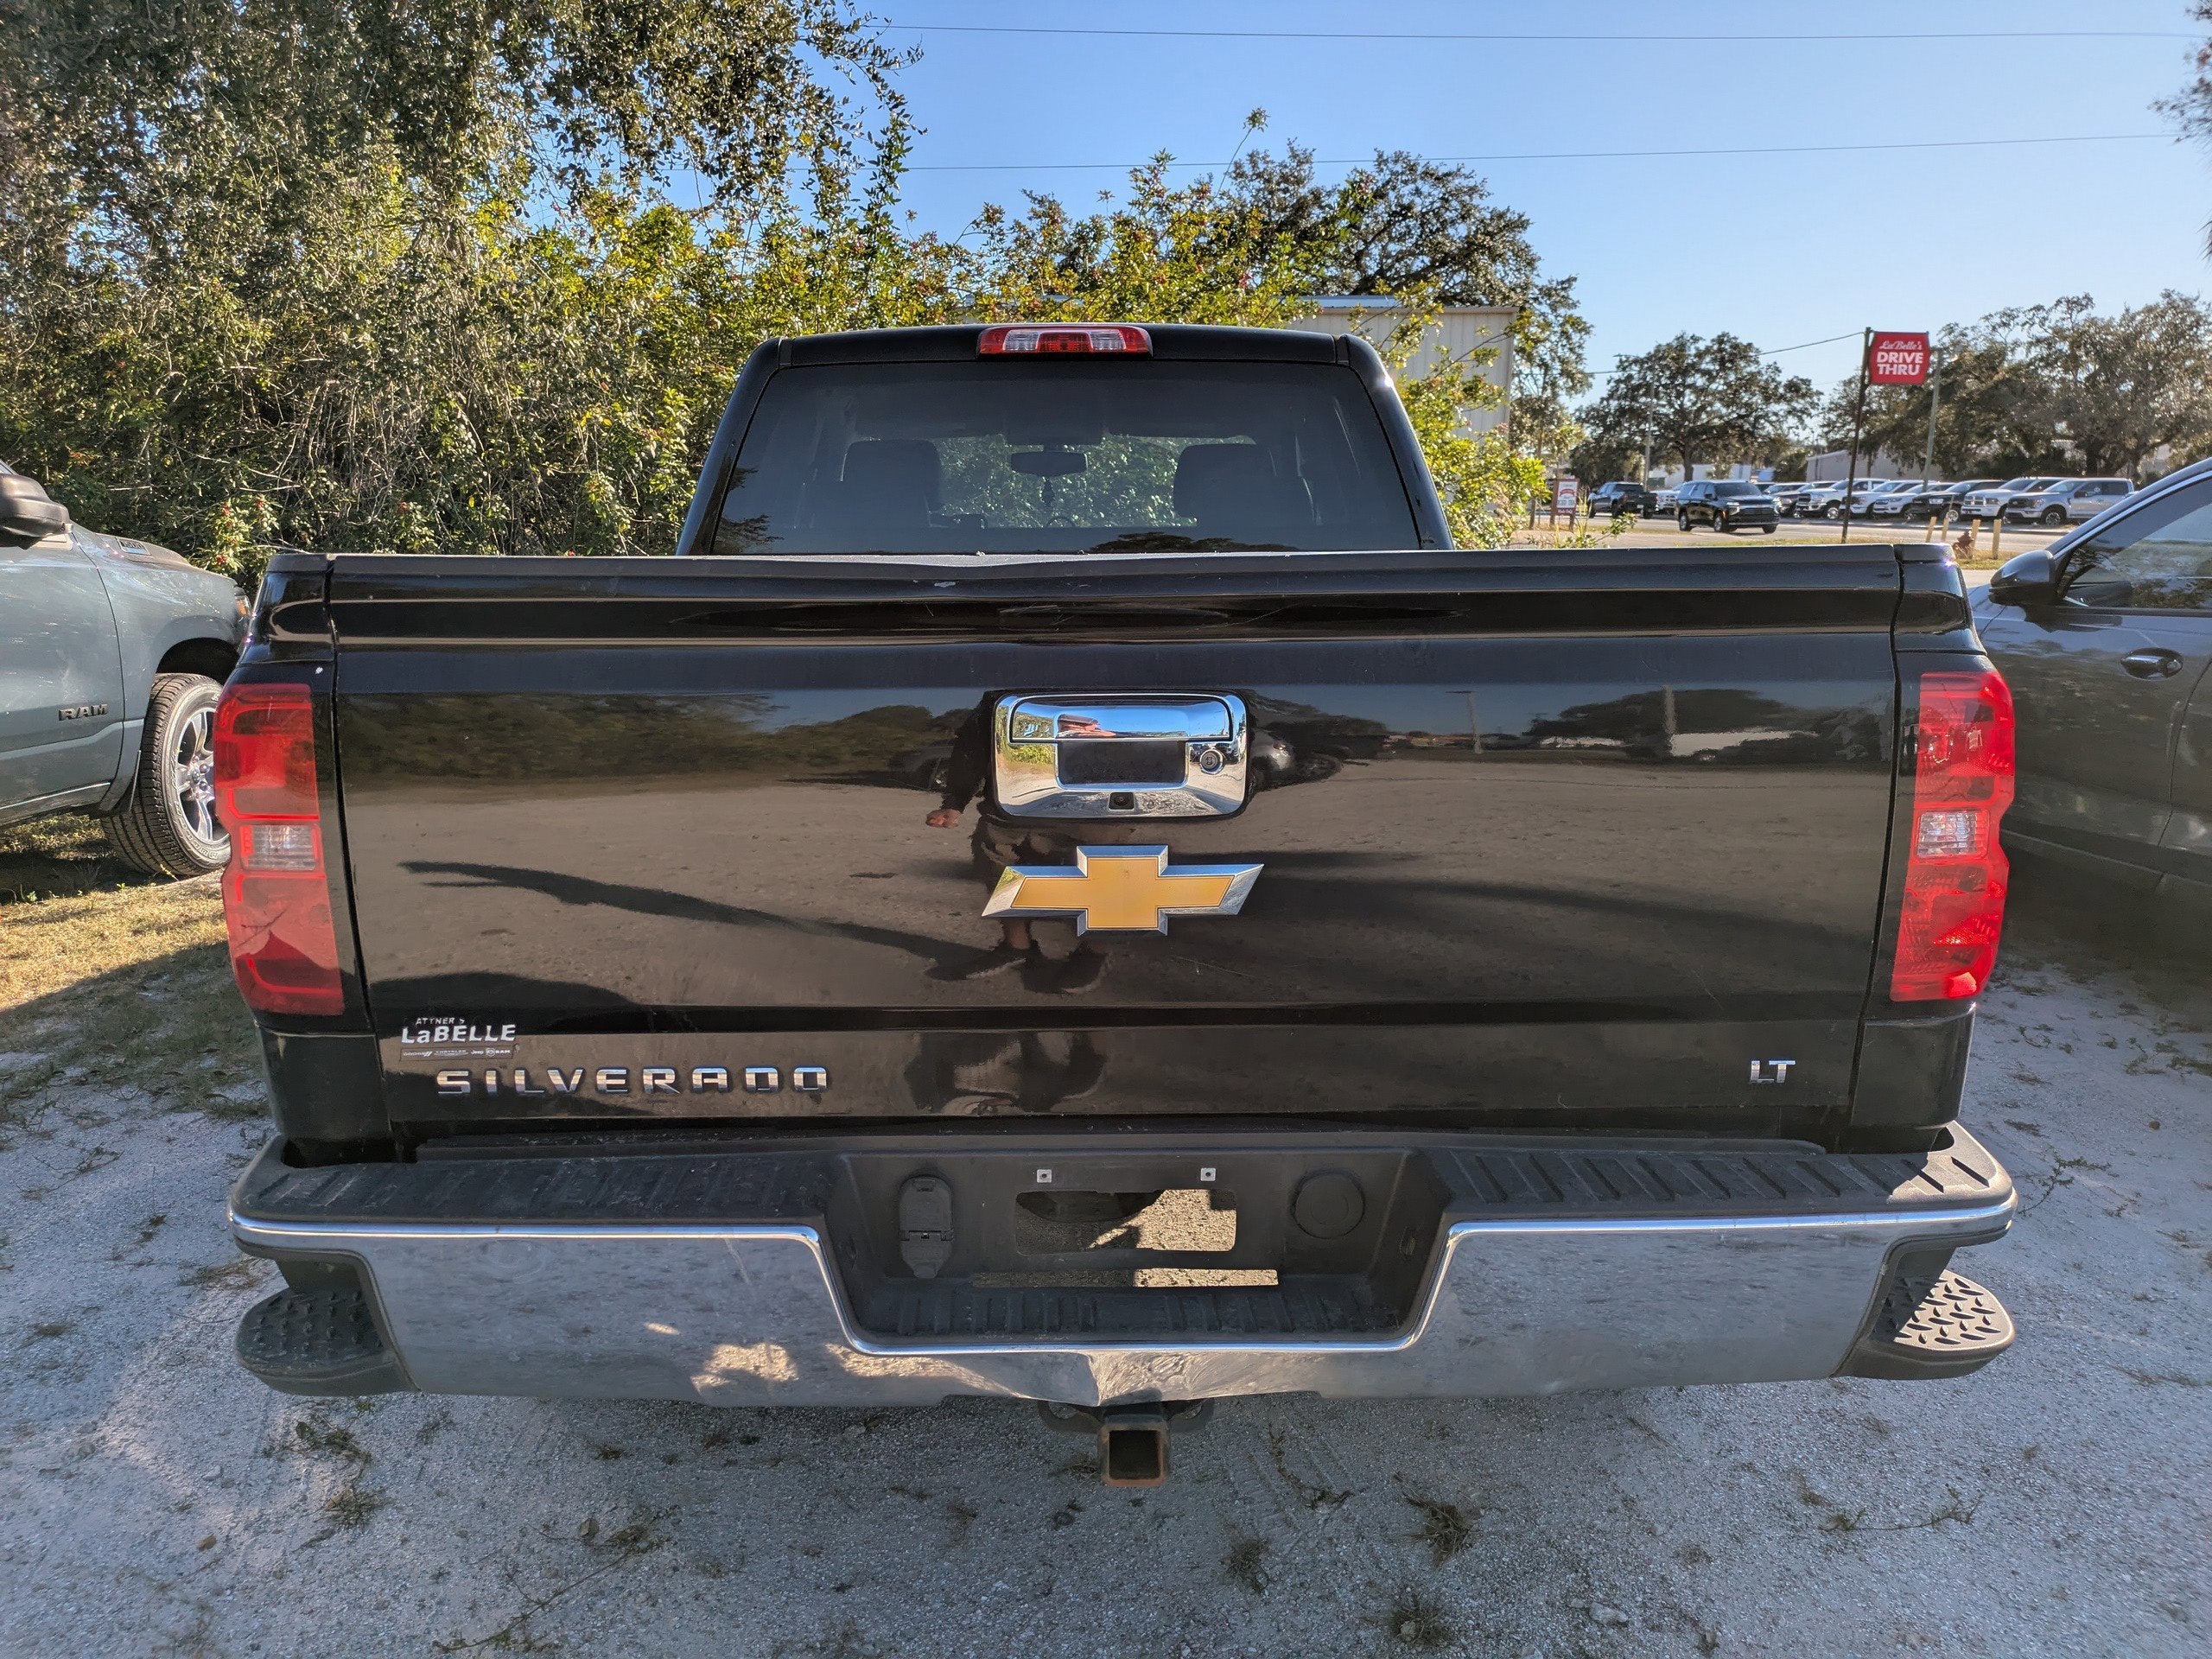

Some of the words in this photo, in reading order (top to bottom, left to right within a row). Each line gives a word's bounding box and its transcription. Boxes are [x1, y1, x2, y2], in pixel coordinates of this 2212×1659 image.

[1877, 352, 1923, 363] DRIVE
[1877, 364, 1920, 376] THRU
[59, 703, 108, 721] RAM
[401, 1024, 516, 1044] LaBELLE
[436, 1067, 828, 1094] SILVERADO
[1750, 1059, 1796, 1084] LT
